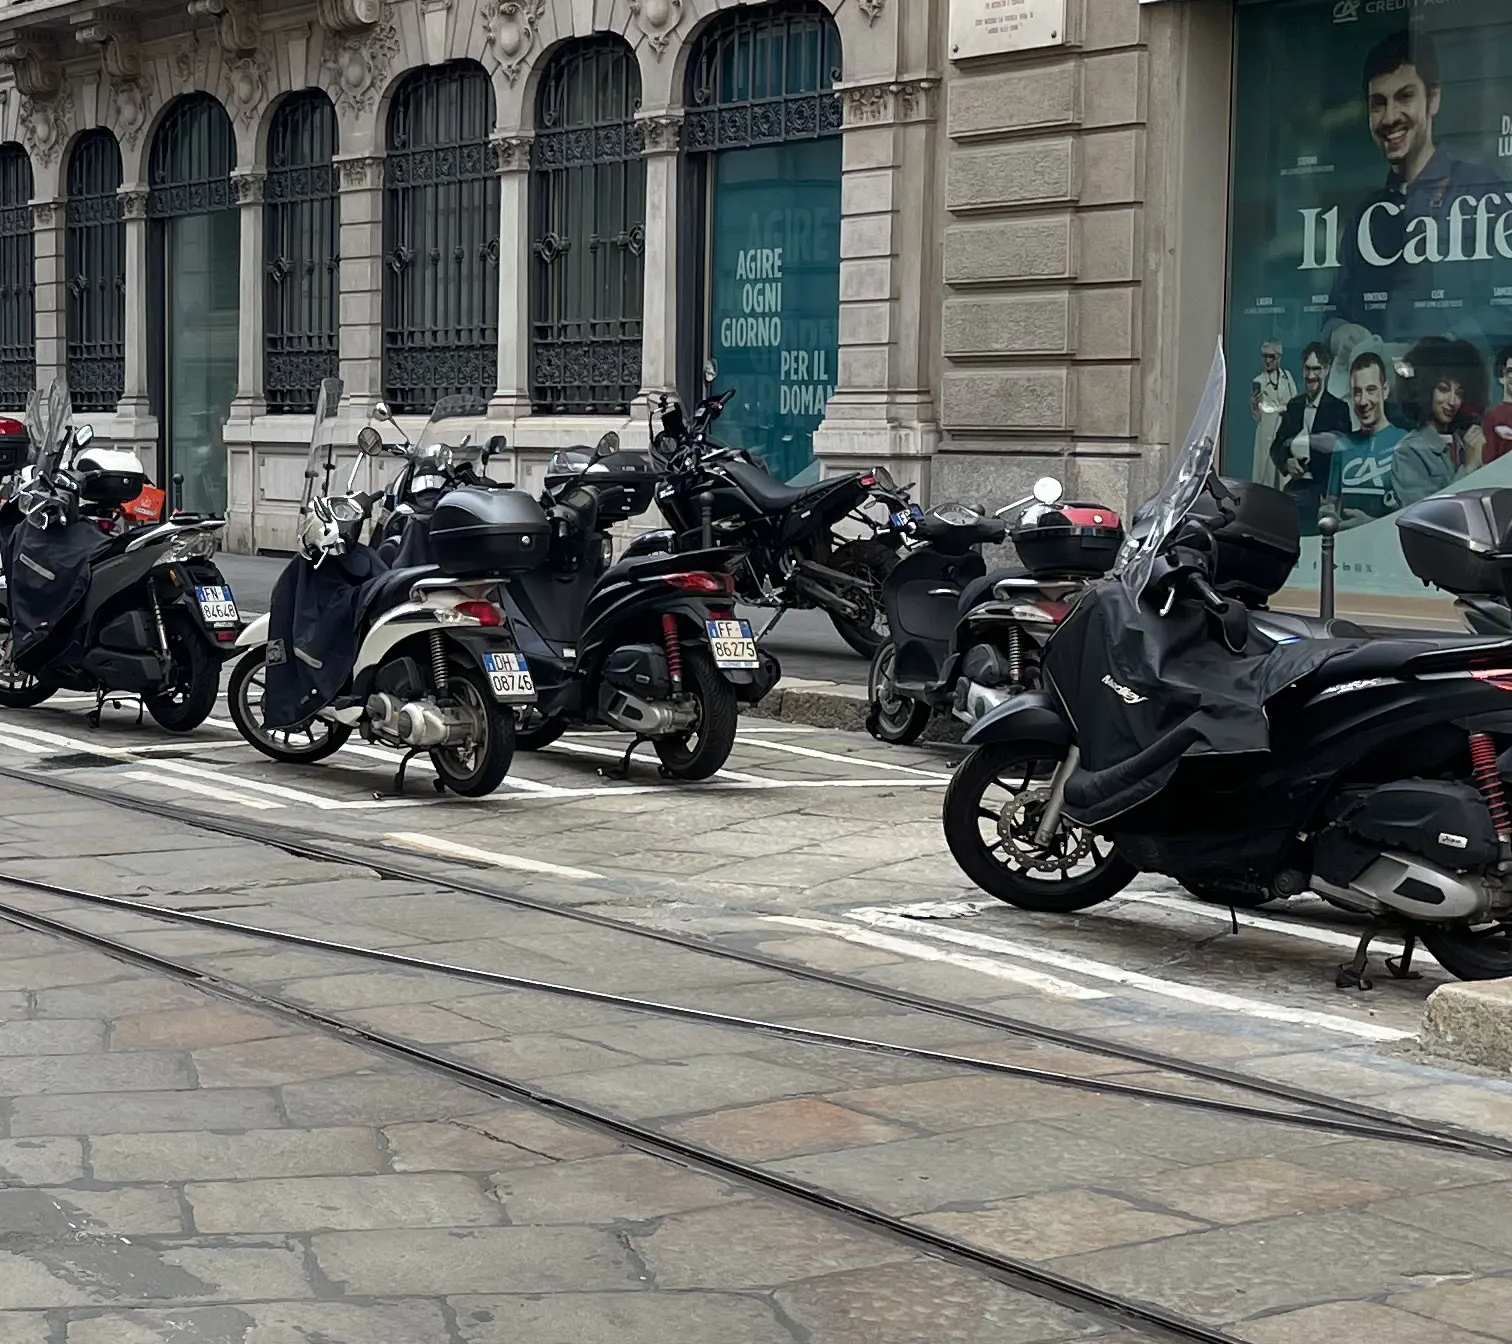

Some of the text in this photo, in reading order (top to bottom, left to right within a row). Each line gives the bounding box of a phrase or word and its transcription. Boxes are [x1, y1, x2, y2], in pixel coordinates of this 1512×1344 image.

[736, 248, 783, 280] AGIRE
[742, 282, 782, 314] OGNI
[720, 317, 781, 347] GIORNO
[780, 349, 828, 381] PER IL
[204, 587, 219, 601] FN
[204, 604, 236, 618] 84648
[717, 622, 733, 637] FF
[715, 641, 755, 657] 86275
[494, 655, 513, 671] DH
[493, 674, 534, 692] 08746
